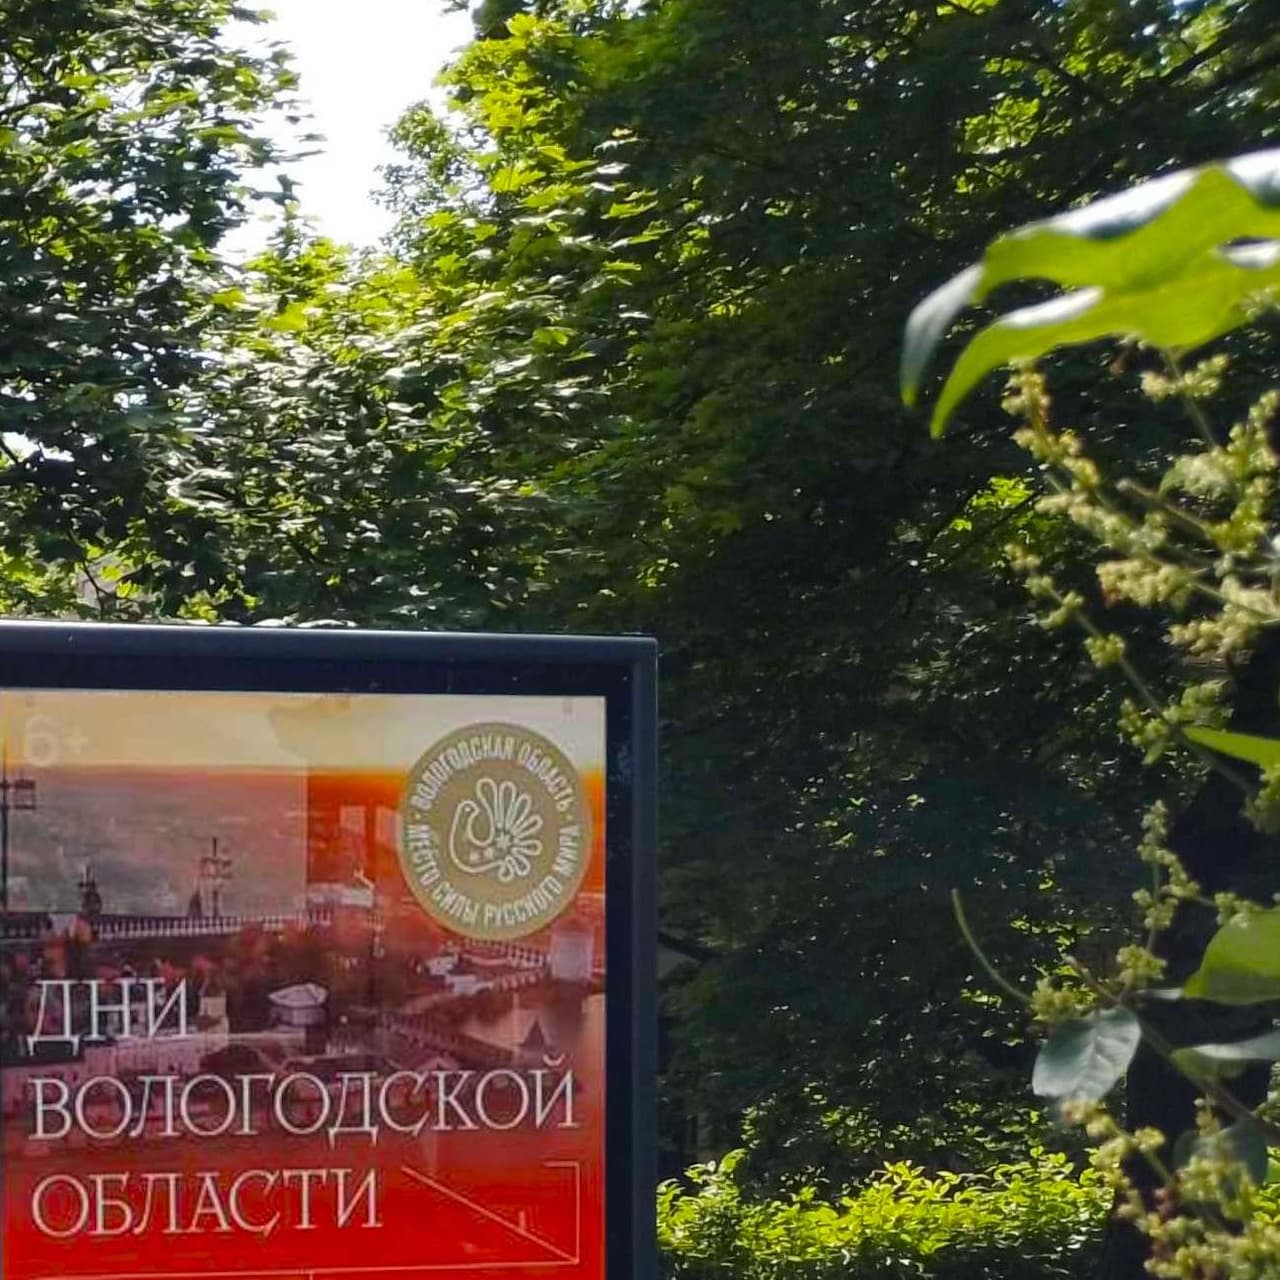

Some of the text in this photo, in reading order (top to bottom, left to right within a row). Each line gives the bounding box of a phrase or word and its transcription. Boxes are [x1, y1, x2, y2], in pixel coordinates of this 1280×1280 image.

[24, 715, 88, 767] 6+
[411, 736, 575, 810] ВОЛОГОДСКАЯ ОБЛАСТЬ
[407, 824, 580, 926] МЕСТО СИЛЫ РУССКОГО МИРА
[27, 977, 189, 1056] ДНИ
[28, 1054, 579, 1149] ВОЛОГОДСКОЙ
[32, 1168, 383, 1237] ОБЛАСТИ
